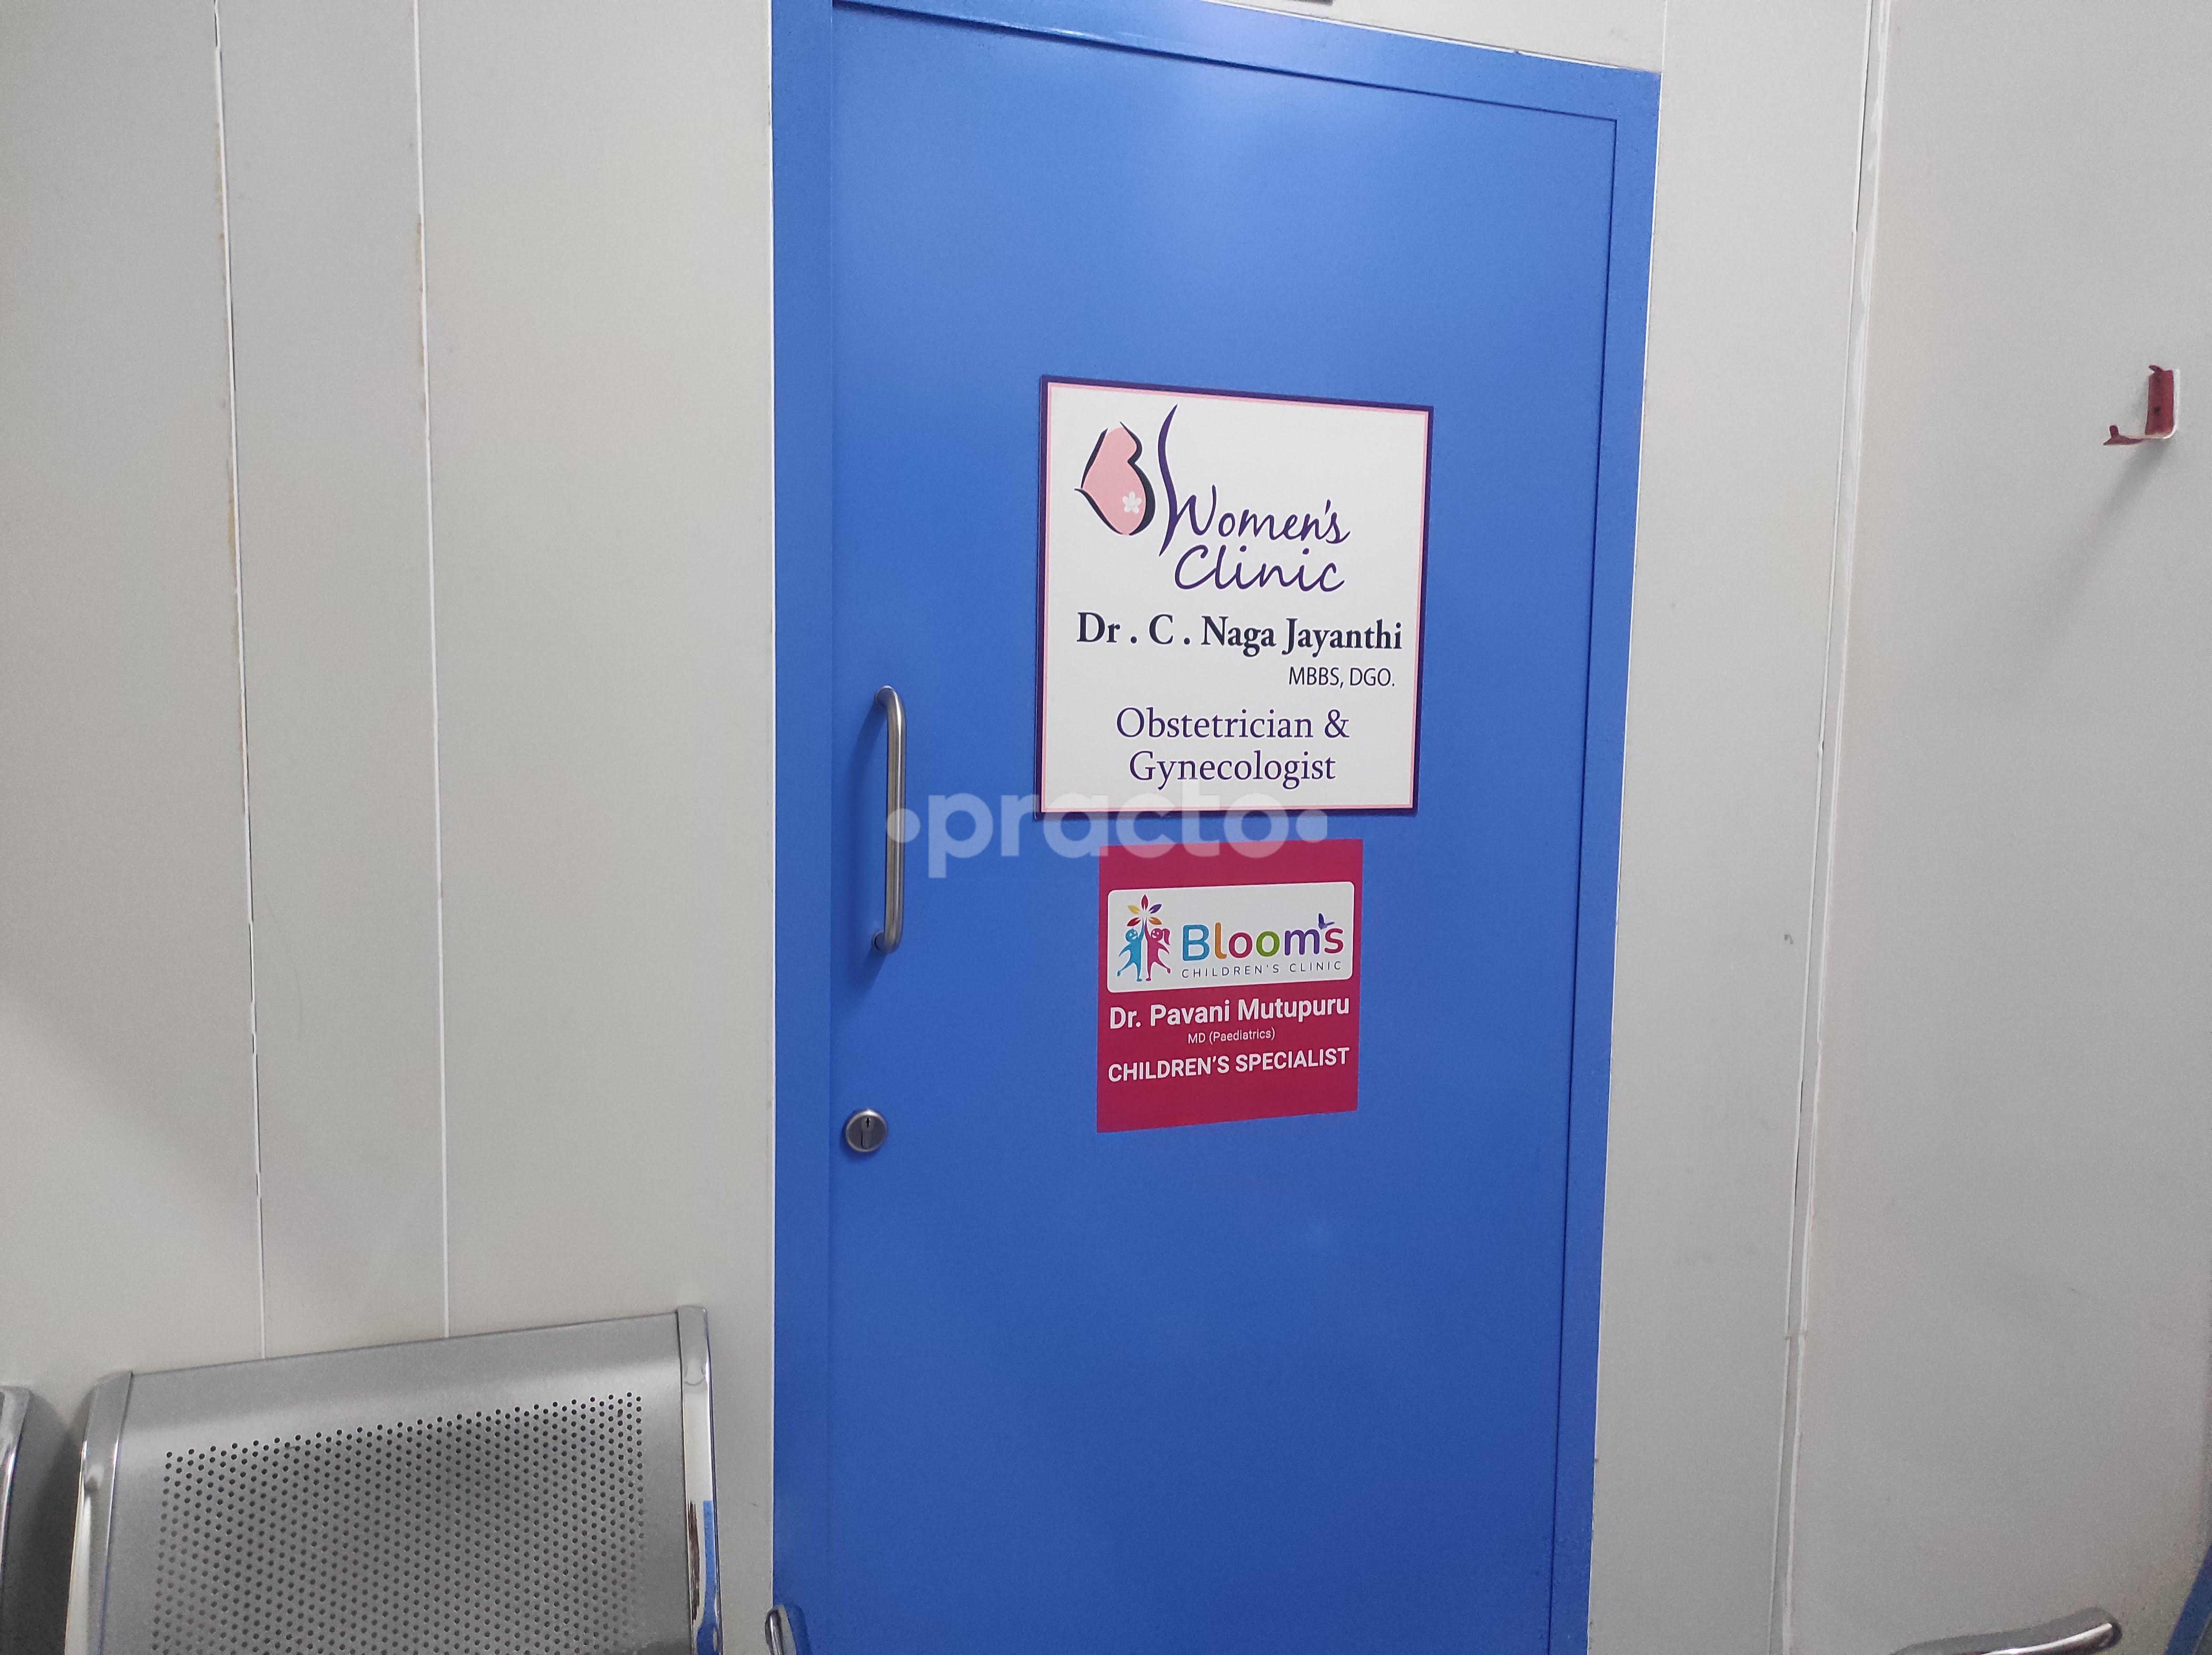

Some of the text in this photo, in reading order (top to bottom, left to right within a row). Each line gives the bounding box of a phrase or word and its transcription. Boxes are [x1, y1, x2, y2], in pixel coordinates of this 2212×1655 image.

[1174, 544, 1345, 593] Clinic
[1200, 615, 1277, 657] Naga
[1281, 617, 1403, 658] Jayanthi
[1288, 666, 1396, 689] MBBS, DGO.
[1116, 706, 1351, 739] Obstetrician &
[1129, 749, 1336, 791] Gynecologist
[1181, 960, 1342, 979] CHILDREN'S CLINIC
[1109, 997, 1350, 1030] Dr. Pavani Mutupuru
[1188, 1027, 1276, 1045] MD (Paediatrics)
[1108, 1046, 1350, 1083] CHILDREN'S SPECIALIST
